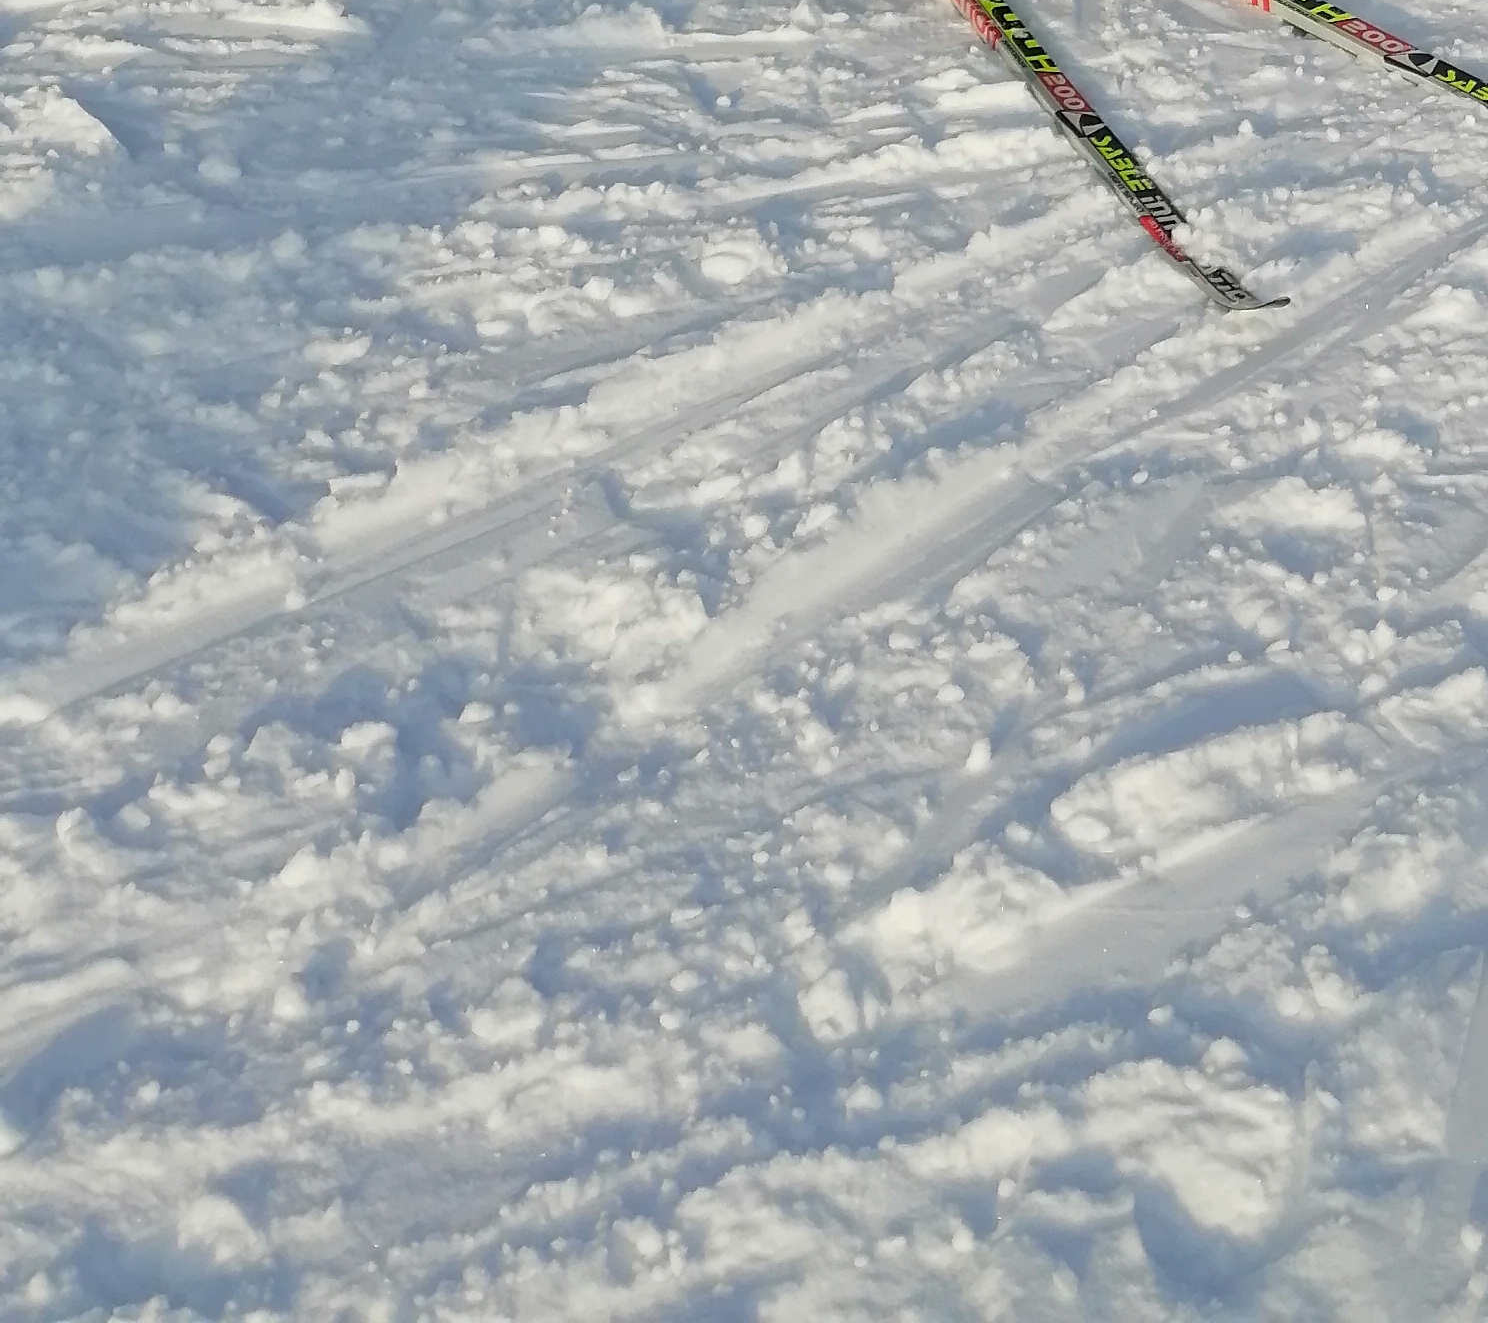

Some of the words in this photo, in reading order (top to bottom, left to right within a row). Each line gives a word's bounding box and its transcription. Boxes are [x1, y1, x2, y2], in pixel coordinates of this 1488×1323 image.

[1341, 20, 1404, 54] 200
[1042, 71, 1086, 111] 200
[1091, 135, 1153, 192] SABLE
